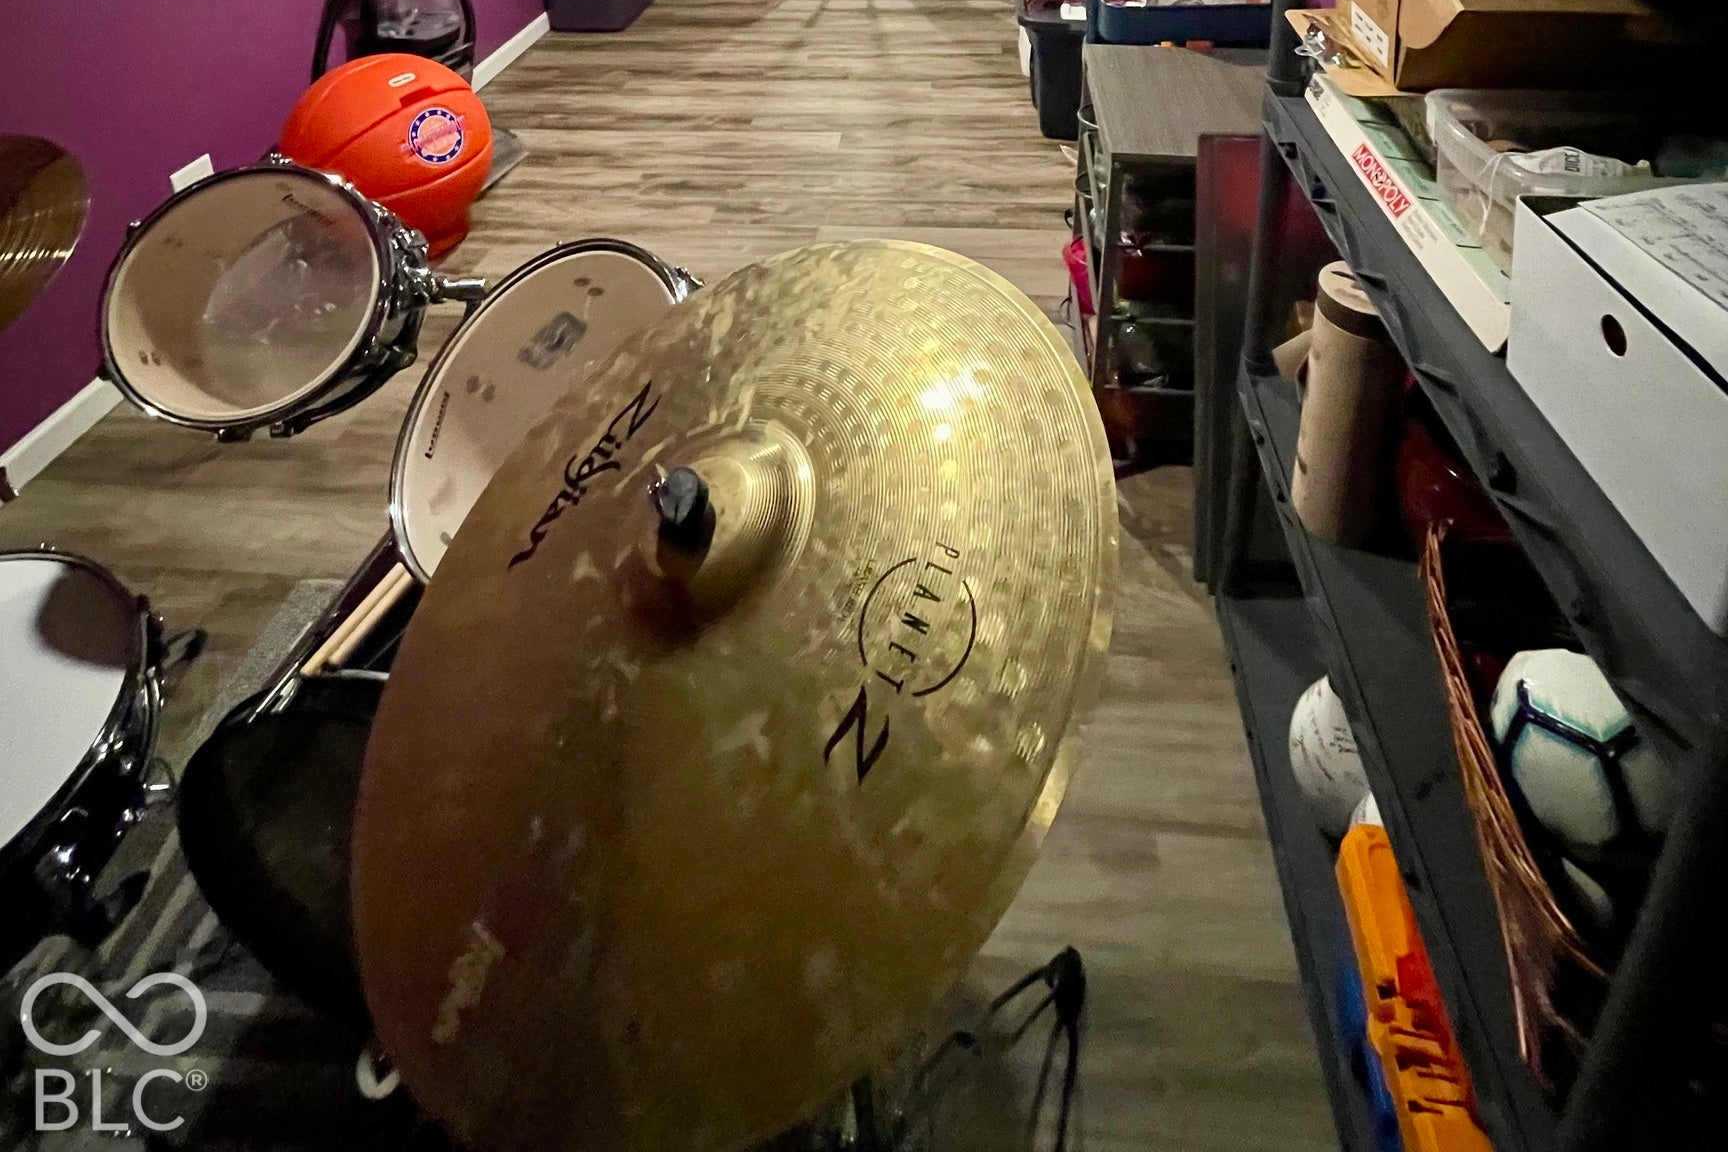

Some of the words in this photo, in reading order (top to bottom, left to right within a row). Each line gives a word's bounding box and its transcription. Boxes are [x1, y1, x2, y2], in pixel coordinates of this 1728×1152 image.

[1353, 146, 1410, 214] MONOPOLY
[507, 378, 662, 572] Zildjian
[875, 542, 961, 695] PLANET
[823, 685, 890, 786] Z
